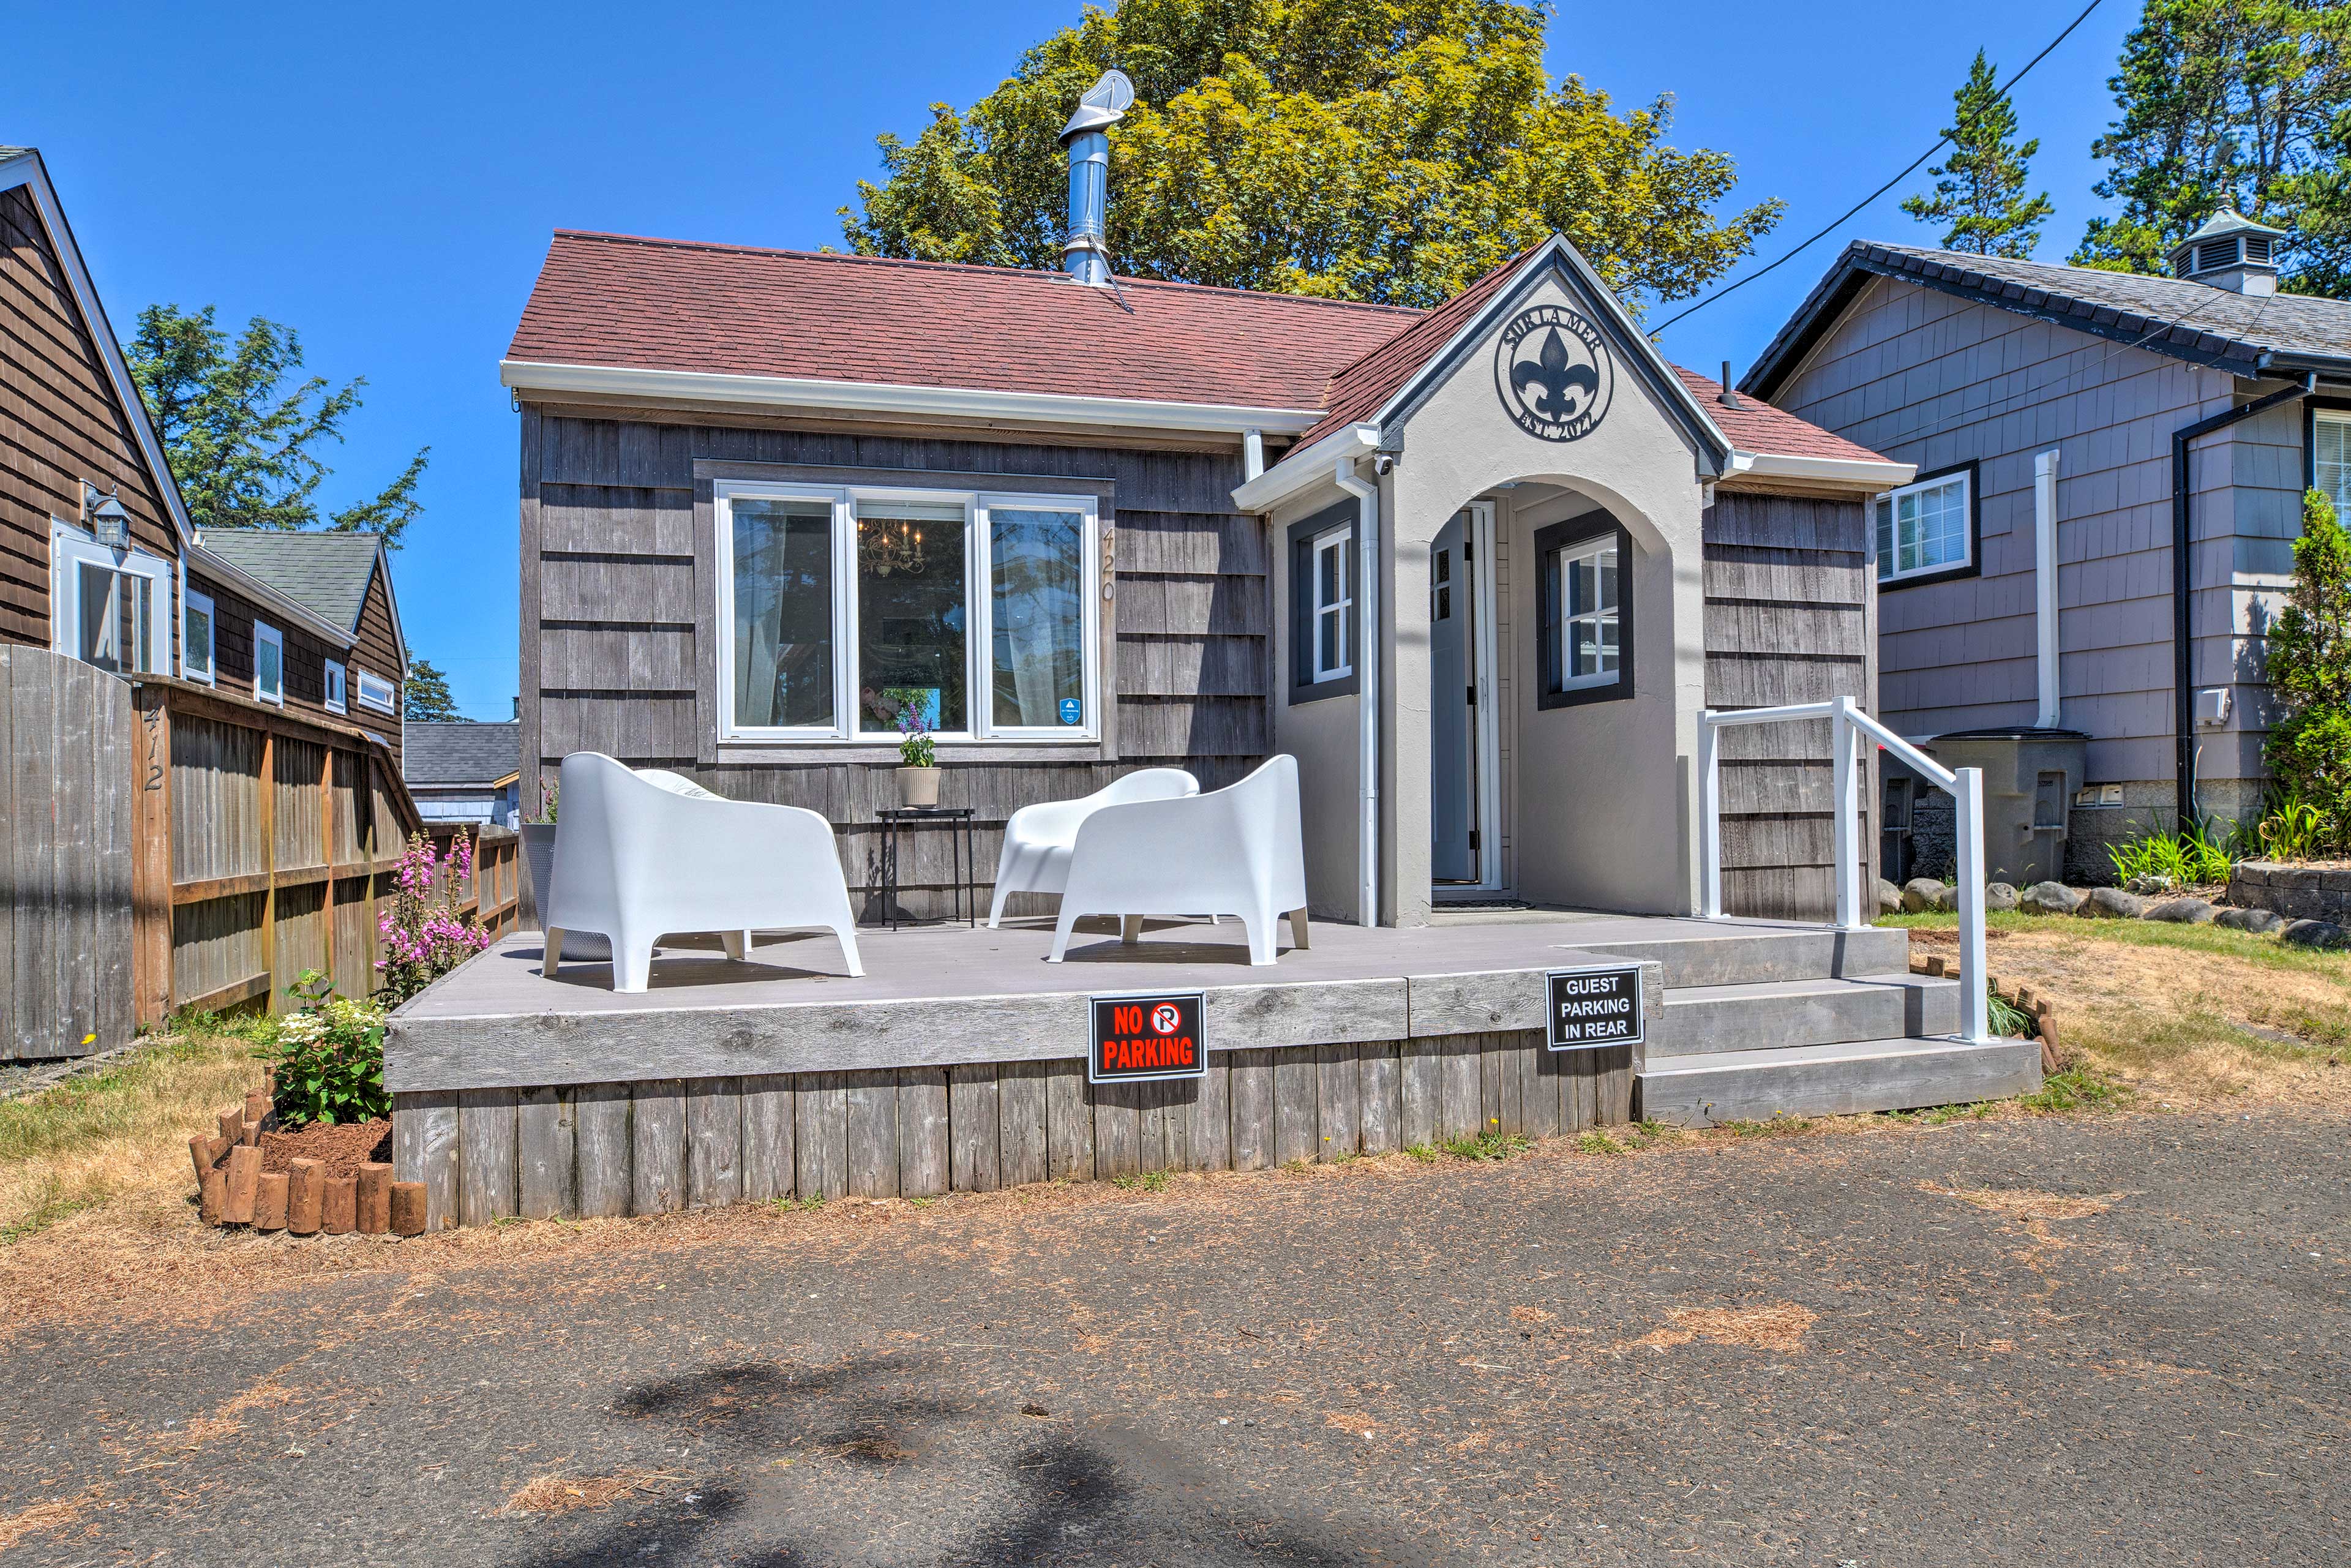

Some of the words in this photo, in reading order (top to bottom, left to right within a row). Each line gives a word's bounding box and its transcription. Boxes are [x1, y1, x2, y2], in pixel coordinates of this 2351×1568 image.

[1504, 313, 1538, 350] SUR
[1566, 313, 1602, 353] MER
[1102, 528, 1114, 602] 420
[144, 705, 163, 792] 412
[1566, 977, 1619, 995] GUEST
[1114, 1006, 1143, 1035] NO
[1561, 997, 1630, 1018] PARKING
[1565, 1024, 1580, 1039] IN
[1586, 1020, 1627, 1038] REAR
[1104, 1037, 1193, 1069] PARKING
